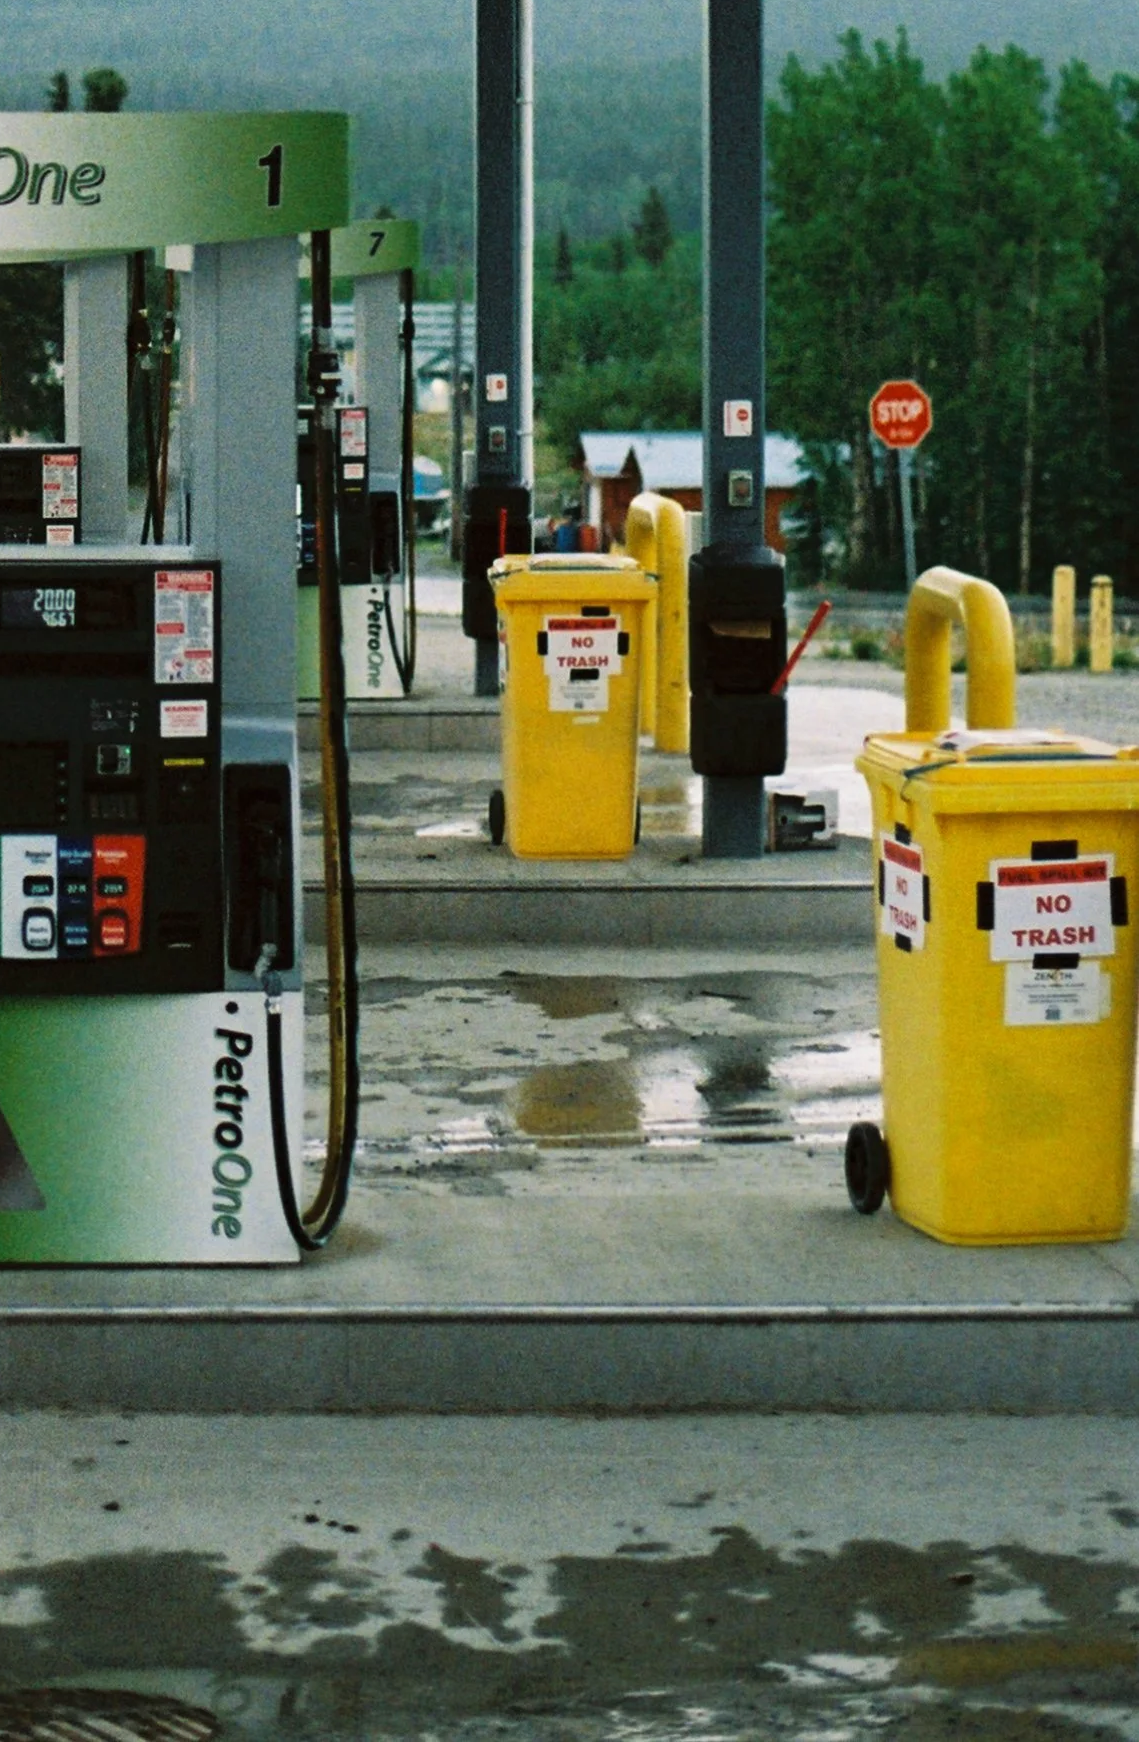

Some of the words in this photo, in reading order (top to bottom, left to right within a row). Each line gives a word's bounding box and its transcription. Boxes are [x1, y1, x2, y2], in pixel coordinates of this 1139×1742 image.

[257, 144, 284, 208] 1
[369, 231, 386, 257] 7
[877, 400, 923, 423] STOP
[366, 598, 385, 689] PetroOne
[571, 636, 594, 649] NO
[556, 655, 610, 668] TRASH
[1035, 894, 1072, 914] NO
[1012, 925, 1096, 947] TRASH
[1034, 971, 1073, 981] ZENTH
[212, 1027, 254, 1240] PetroOne
